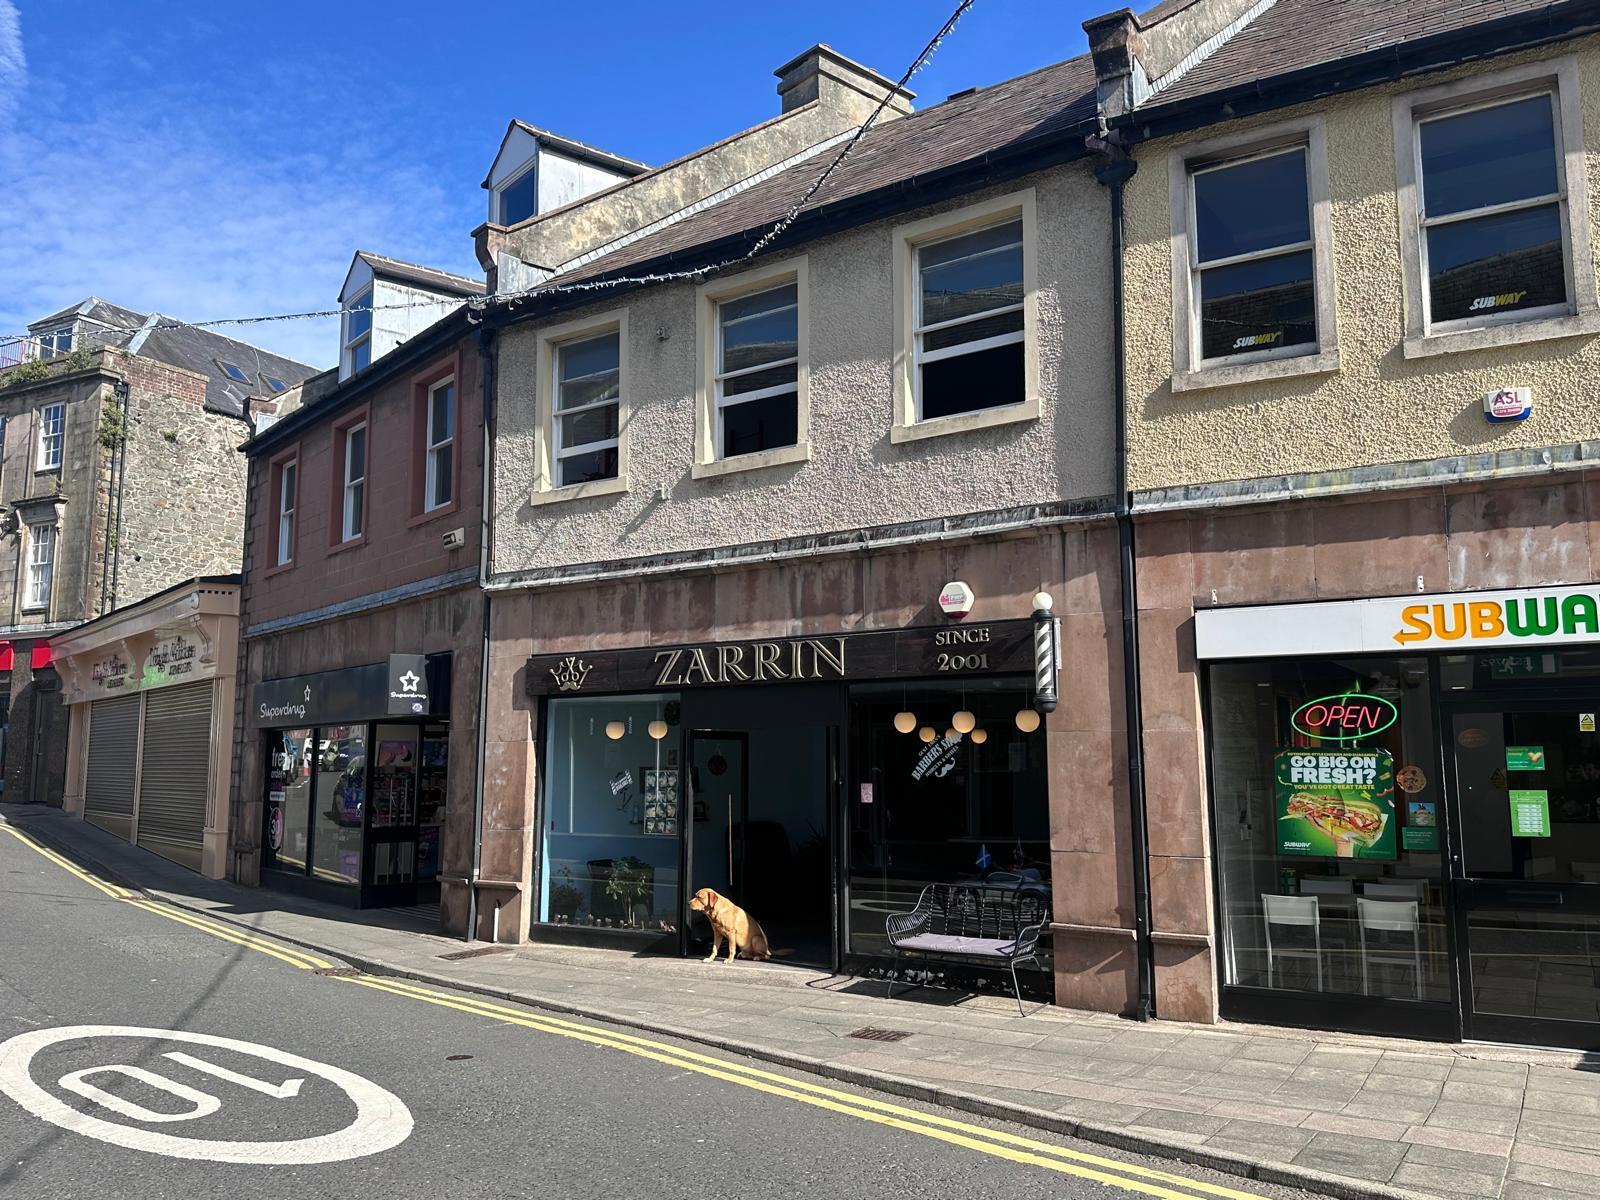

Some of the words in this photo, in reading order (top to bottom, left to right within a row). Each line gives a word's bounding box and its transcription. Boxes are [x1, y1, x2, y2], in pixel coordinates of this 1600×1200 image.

[1469, 290, 1527, 311] SUBWAY
[1233, 331, 1281, 349] SUBWAY
[1493, 391, 1522, 405] ASL
[1392, 593, 1600, 646] SUBWA
[935, 628, 990, 646] SINCE
[654, 637, 849, 686] ZARRIN
[937, 653, 989, 671] 2001
[390, 691, 427, 700] Superdrug
[259, 702, 306, 720] Superdrug
[1305, 705, 1381, 729] OPEN
[911, 743, 943, 781] BARBERS
[1290, 755, 1317, 768] GO
[1318, 756, 1349, 769] BIG
[1349, 756, 1377, 769] ON
[1290, 767, 1377, 785] FRESH?
